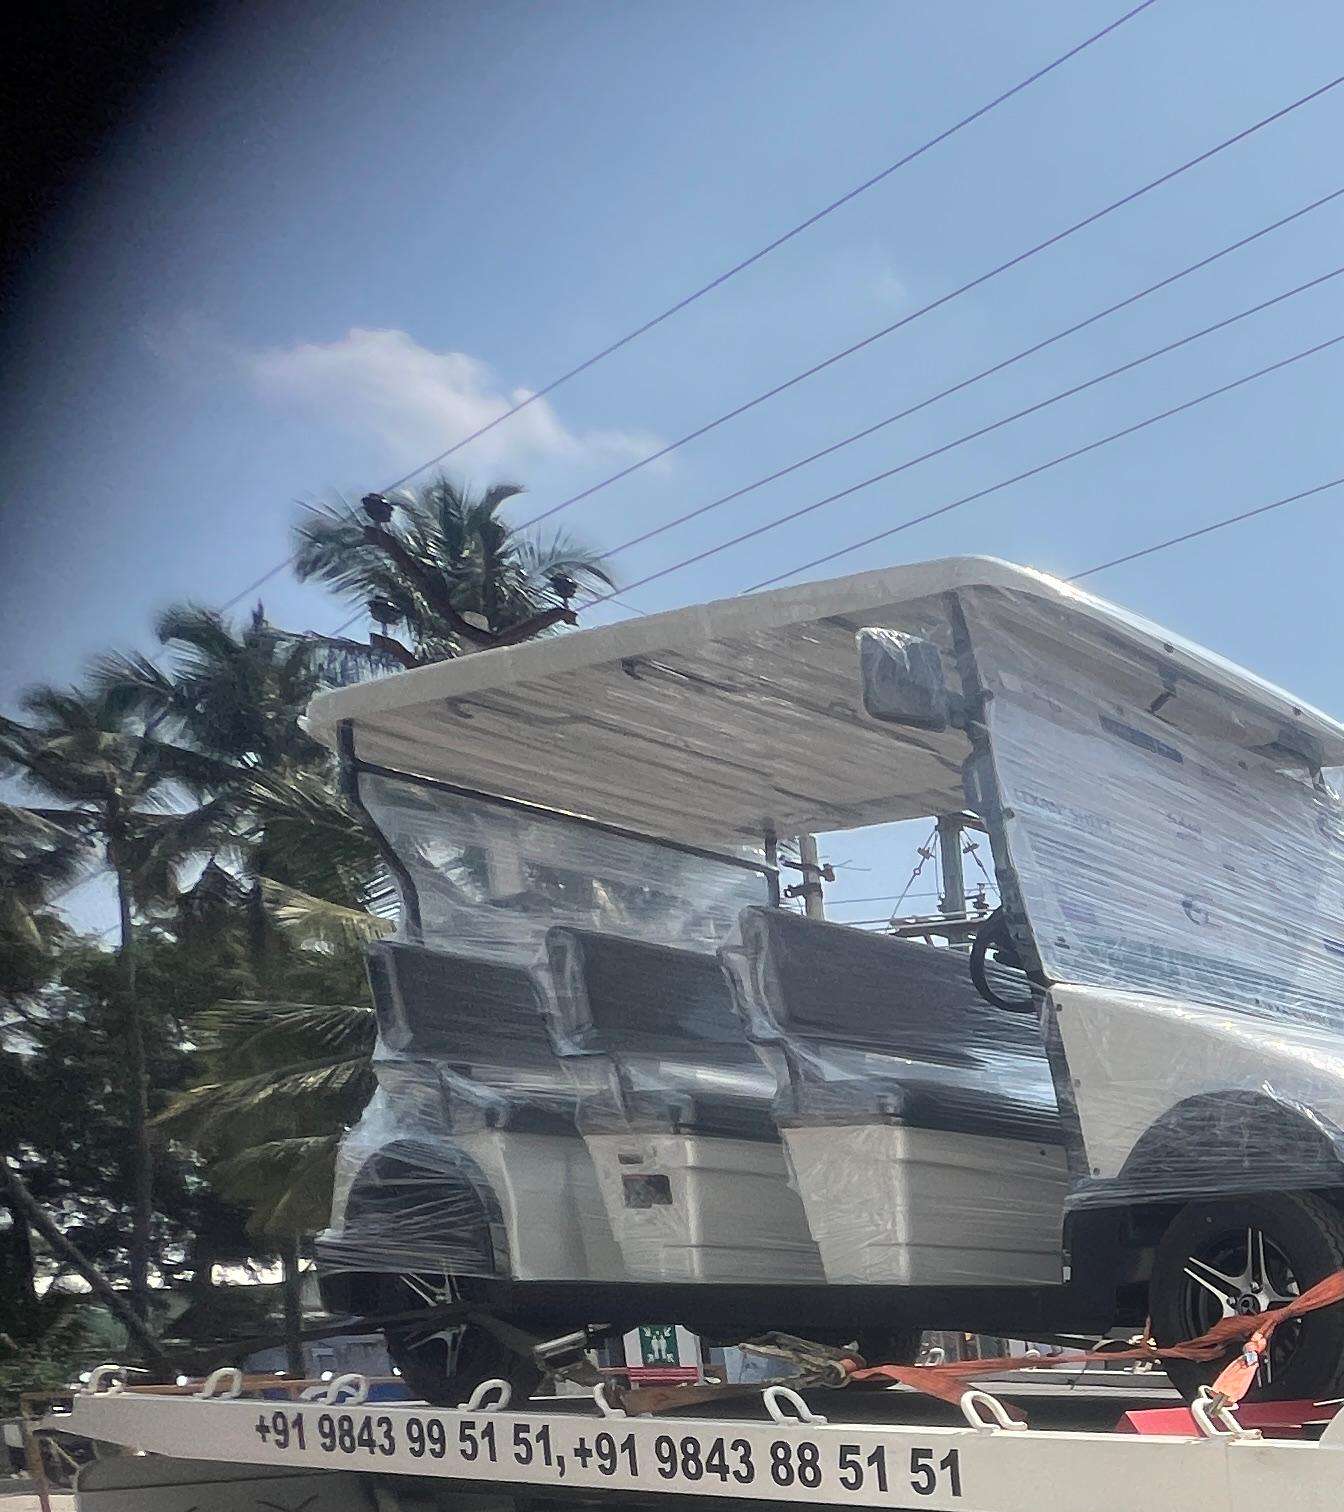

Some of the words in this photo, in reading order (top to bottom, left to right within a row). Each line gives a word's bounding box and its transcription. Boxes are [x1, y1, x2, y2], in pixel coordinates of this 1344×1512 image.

[255, 1410, 307, 1450] +91
[317, 1413, 396, 1456] 9843
[406, 1417, 447, 1459] 99
[458, 1420, 498, 1462] 51
[653, 1434, 756, 1484] 9843
[769, 1440, 823, 1489] 88
[838, 1443, 889, 1493] 51
[909, 1447, 963, 1497] 51
